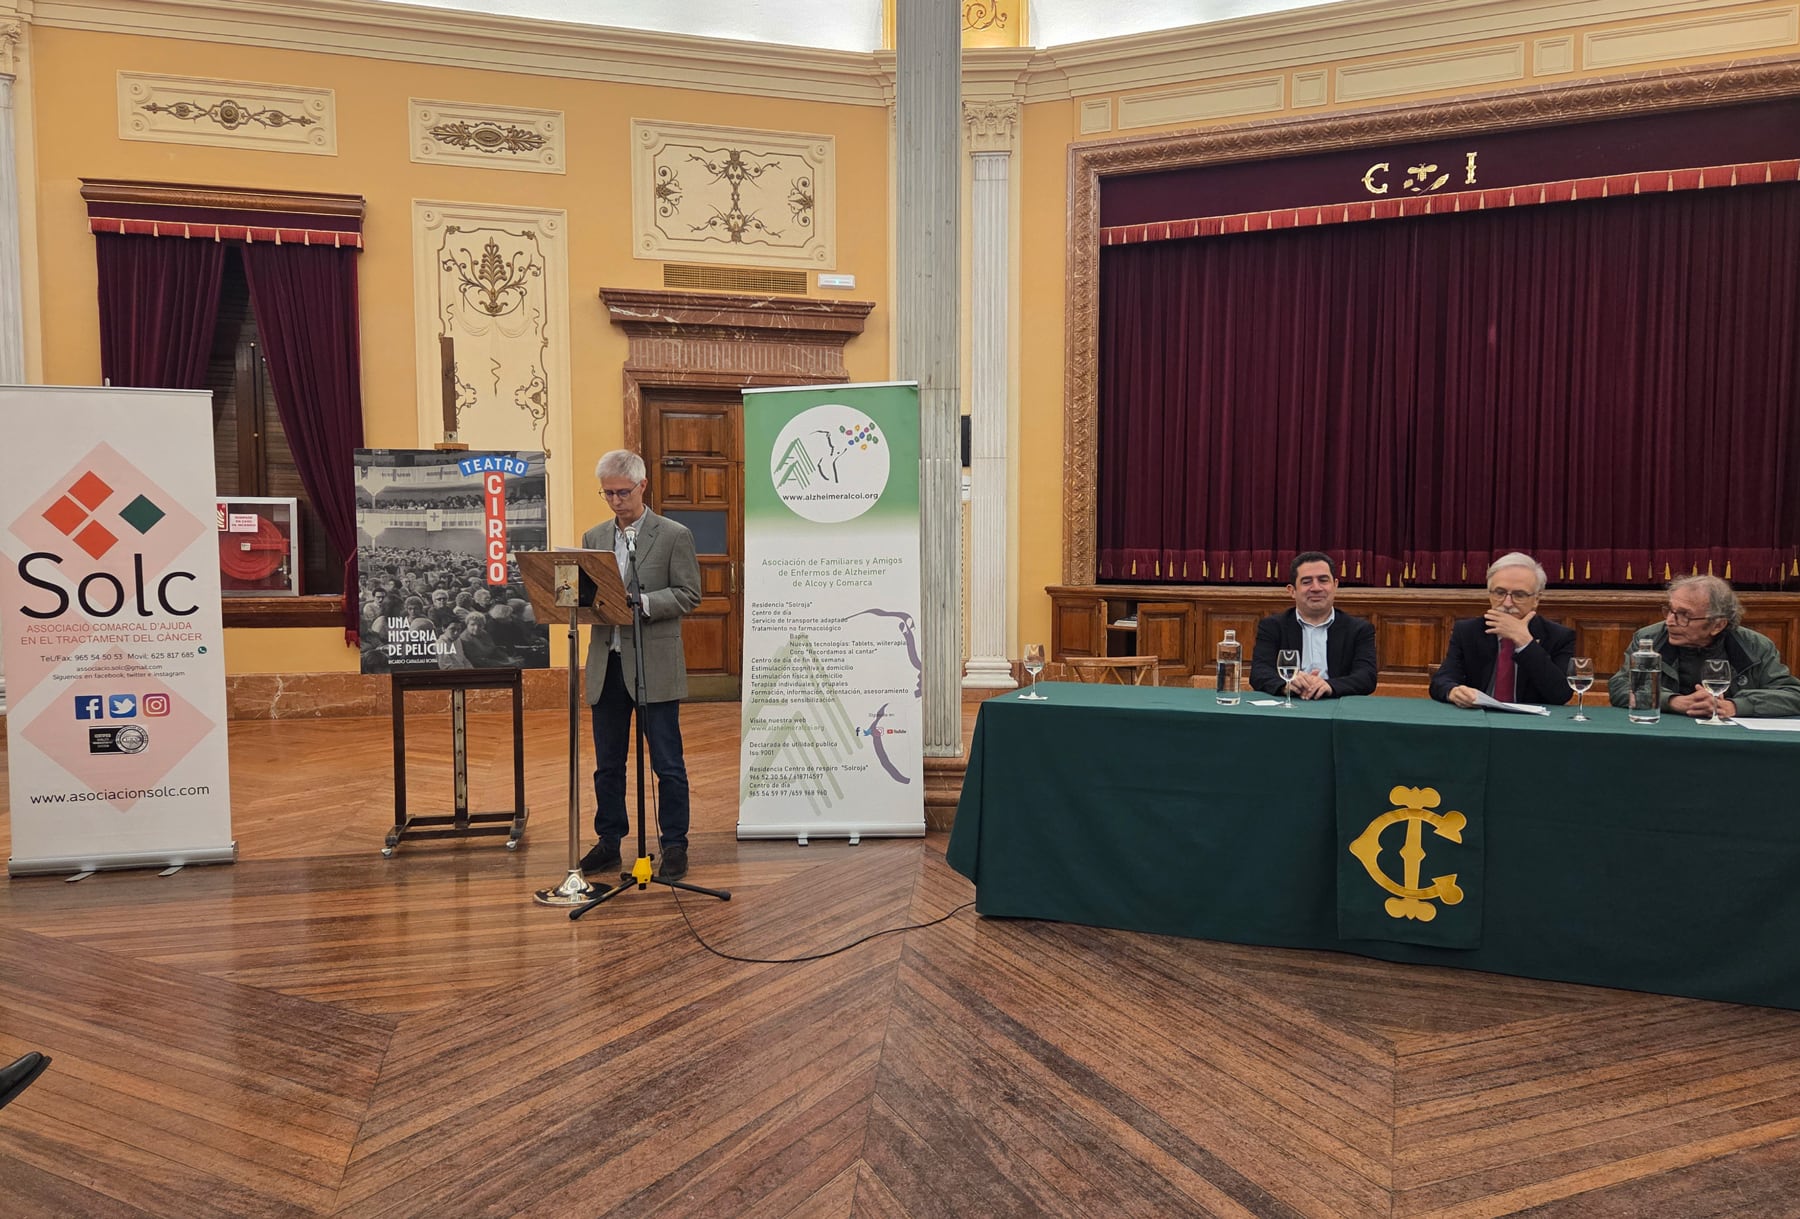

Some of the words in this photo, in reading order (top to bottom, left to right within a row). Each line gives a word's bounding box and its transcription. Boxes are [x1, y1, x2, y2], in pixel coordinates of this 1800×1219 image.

[462, 458, 525, 474] TEATRO
[487, 474, 504, 582] CIRCO
[761, 558, 806, 566] Asociación
[808, 558, 818, 566] de
[820, 557, 864, 565] Familiares
[865, 558, 870, 566] y
[872, 557, 903, 566] Amigos
[778, 568, 788, 577] de
[791, 568, 830, 576] Enfermos
[832, 568, 842, 576] de
[845, 568, 886, 576] Alzheimer
[17, 551, 200, 619] Solc
[792, 579, 802, 587] de
[804, 579, 827, 588] Alcoy
[836, 578, 872, 586] Comarca
[26, 622, 90, 633] ASSOCIACIÓ
[92, 622, 147, 632] COMARCAL
[150, 621, 192, 631] D'AJUDA
[387, 616, 410, 629] UNA
[798, 625, 842, 633] farmacológico
[20, 636, 36, 645] EN
[39, 636, 53, 645] EL
[56, 634, 130, 645] TRACTAMENT
[133, 634, 154, 643] DEL
[387, 629, 437, 642] HISTORIA
[388, 644, 403, 656] DE
[405, 641, 457, 656] PELÍCULA
[150, 652, 165, 660] 625
[181, 651, 194, 659] 685
[153, 670, 186, 678] instagram
[29, 785, 211, 805] www.asociacionsolc.com
